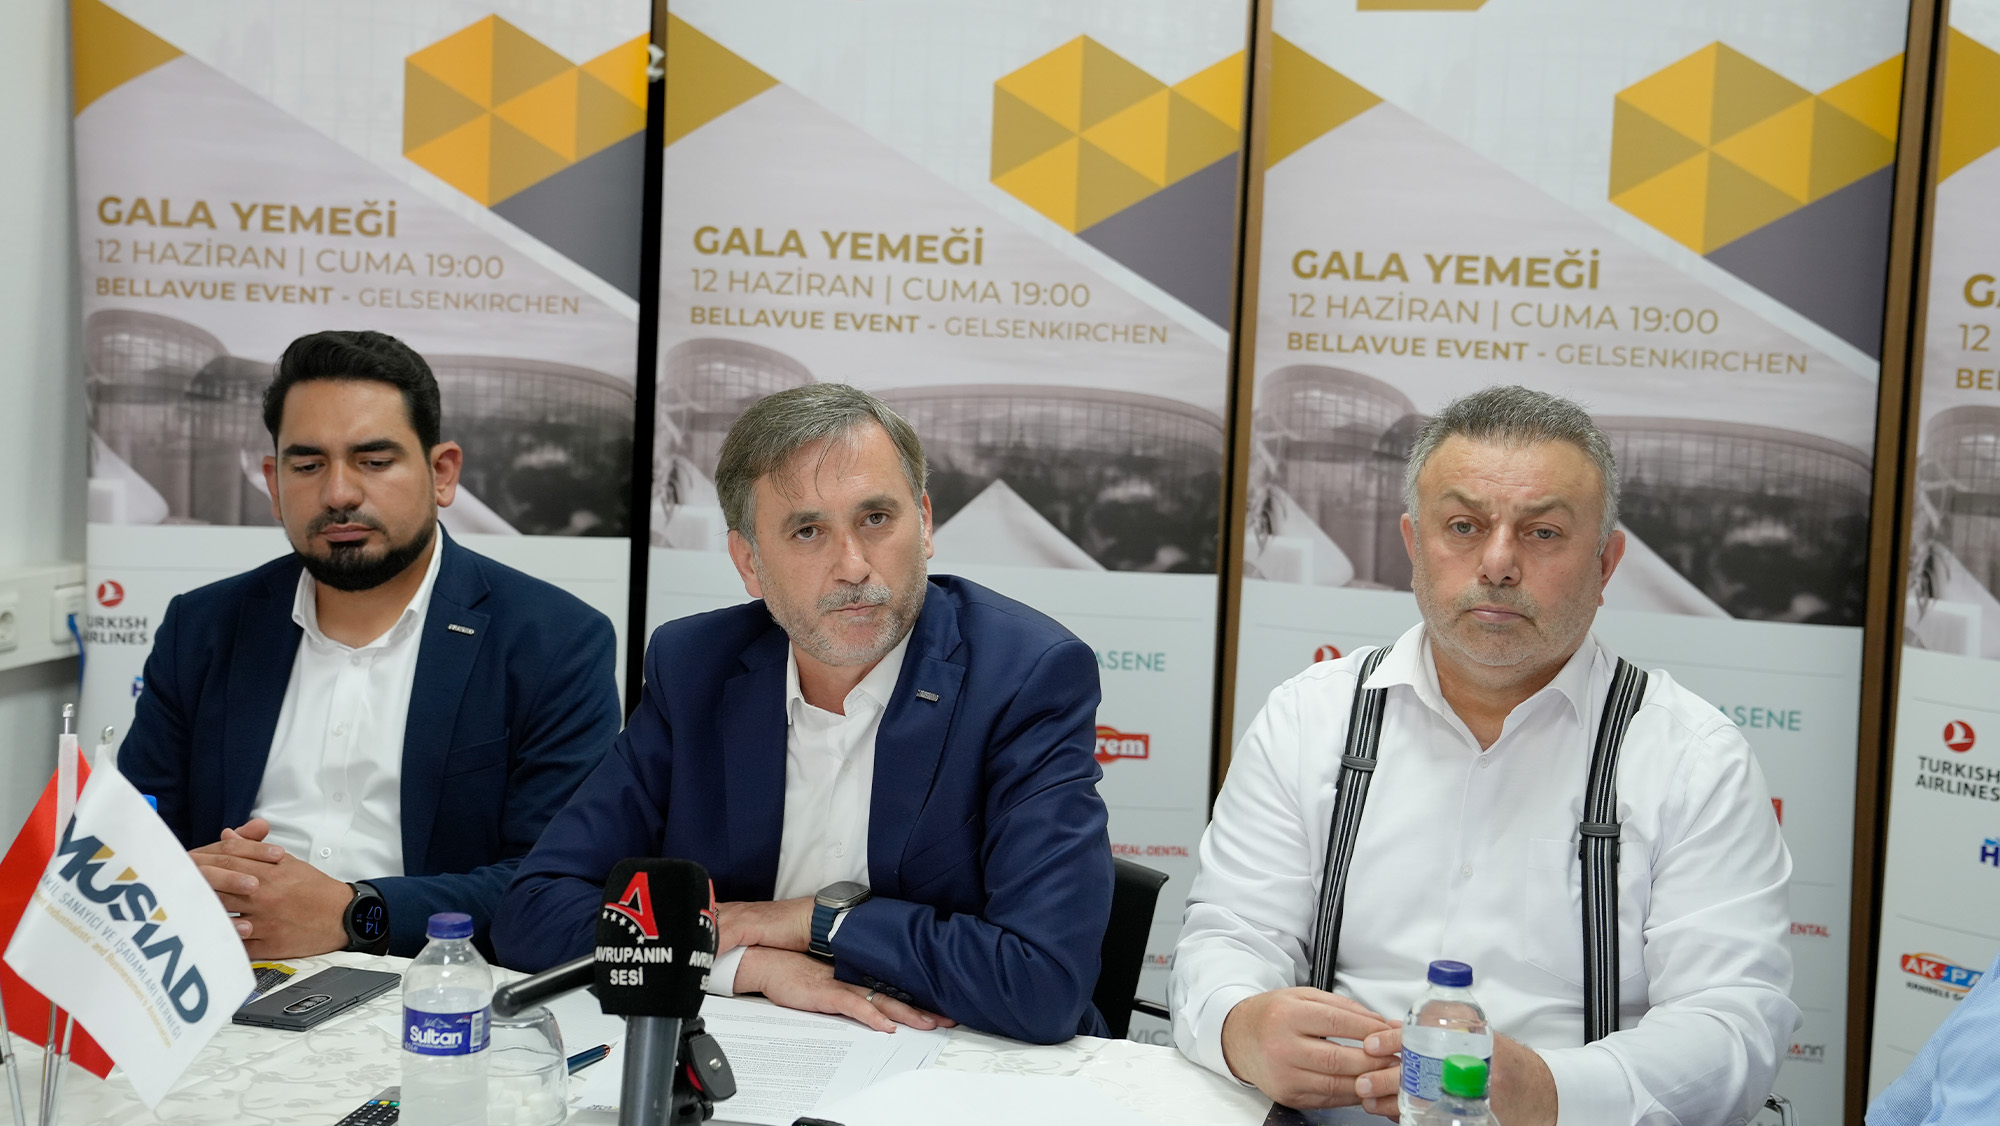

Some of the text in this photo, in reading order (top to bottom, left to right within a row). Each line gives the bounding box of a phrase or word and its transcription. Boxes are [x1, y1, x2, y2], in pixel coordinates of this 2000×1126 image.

[97, 196, 397, 238] GALA YEMEĞİ
[96, 238, 122, 264] 12
[132, 238, 286, 270] HAZİRAN
[316, 249, 416, 276] CUMA
[425, 253, 505, 280] 19:00
[693, 226, 983, 266] GALA YEMEĞİ
[1291, 249, 1600, 290] GALA YEMEĞİ
[95, 277, 236, 301] BELLAVUE
[245, 283, 335, 305] EVENT
[358, 287, 580, 315] GELSENKIRCHEN
[691, 268, 718, 293] 12
[728, 267, 874, 298] HAZİRAN
[902, 277, 1001, 304] CUMA
[1011, 281, 1090, 308] 19:00
[1963, 273, 2000, 308] G
[690, 306, 825, 329] BELLAVUE
[834, 312, 920, 334] EVENT
[944, 316, 1168, 345] GELSENKIRCHEN
[1288, 293, 1316, 318] 12
[1326, 292, 1479, 324] HAZİRAN
[1510, 302, 1619, 330] CUMA
[1629, 306, 1719, 334] 19:00
[1958, 323, 1991, 351] 12
[1287, 332, 1427, 356] BELLAVUE
[1436, 338, 1529, 361] EVENT
[1555, 343, 1807, 374] GELSENKIRCHEN
[1956, 367, 2000, 391] BE
[86, 615, 147, 629] URKISH
[1096, 738, 1146, 756] rem
[1918, 756, 2000, 784] TURKISH
[1915, 774, 2000, 802] AIRLINES
[1111, 843, 1189, 857] DEAL-DENTAL
[1980, 845, 2000, 867] H
[58, 813, 209, 1024] MÜSİAD
[1790, 922, 1830, 938] ENTAL
[101, 925, 117, 942] VE
[594, 946, 673, 964] AVRUPANIN
[610, 966, 644, 986] SESİ
[410, 1025, 463, 1045] Sultan
